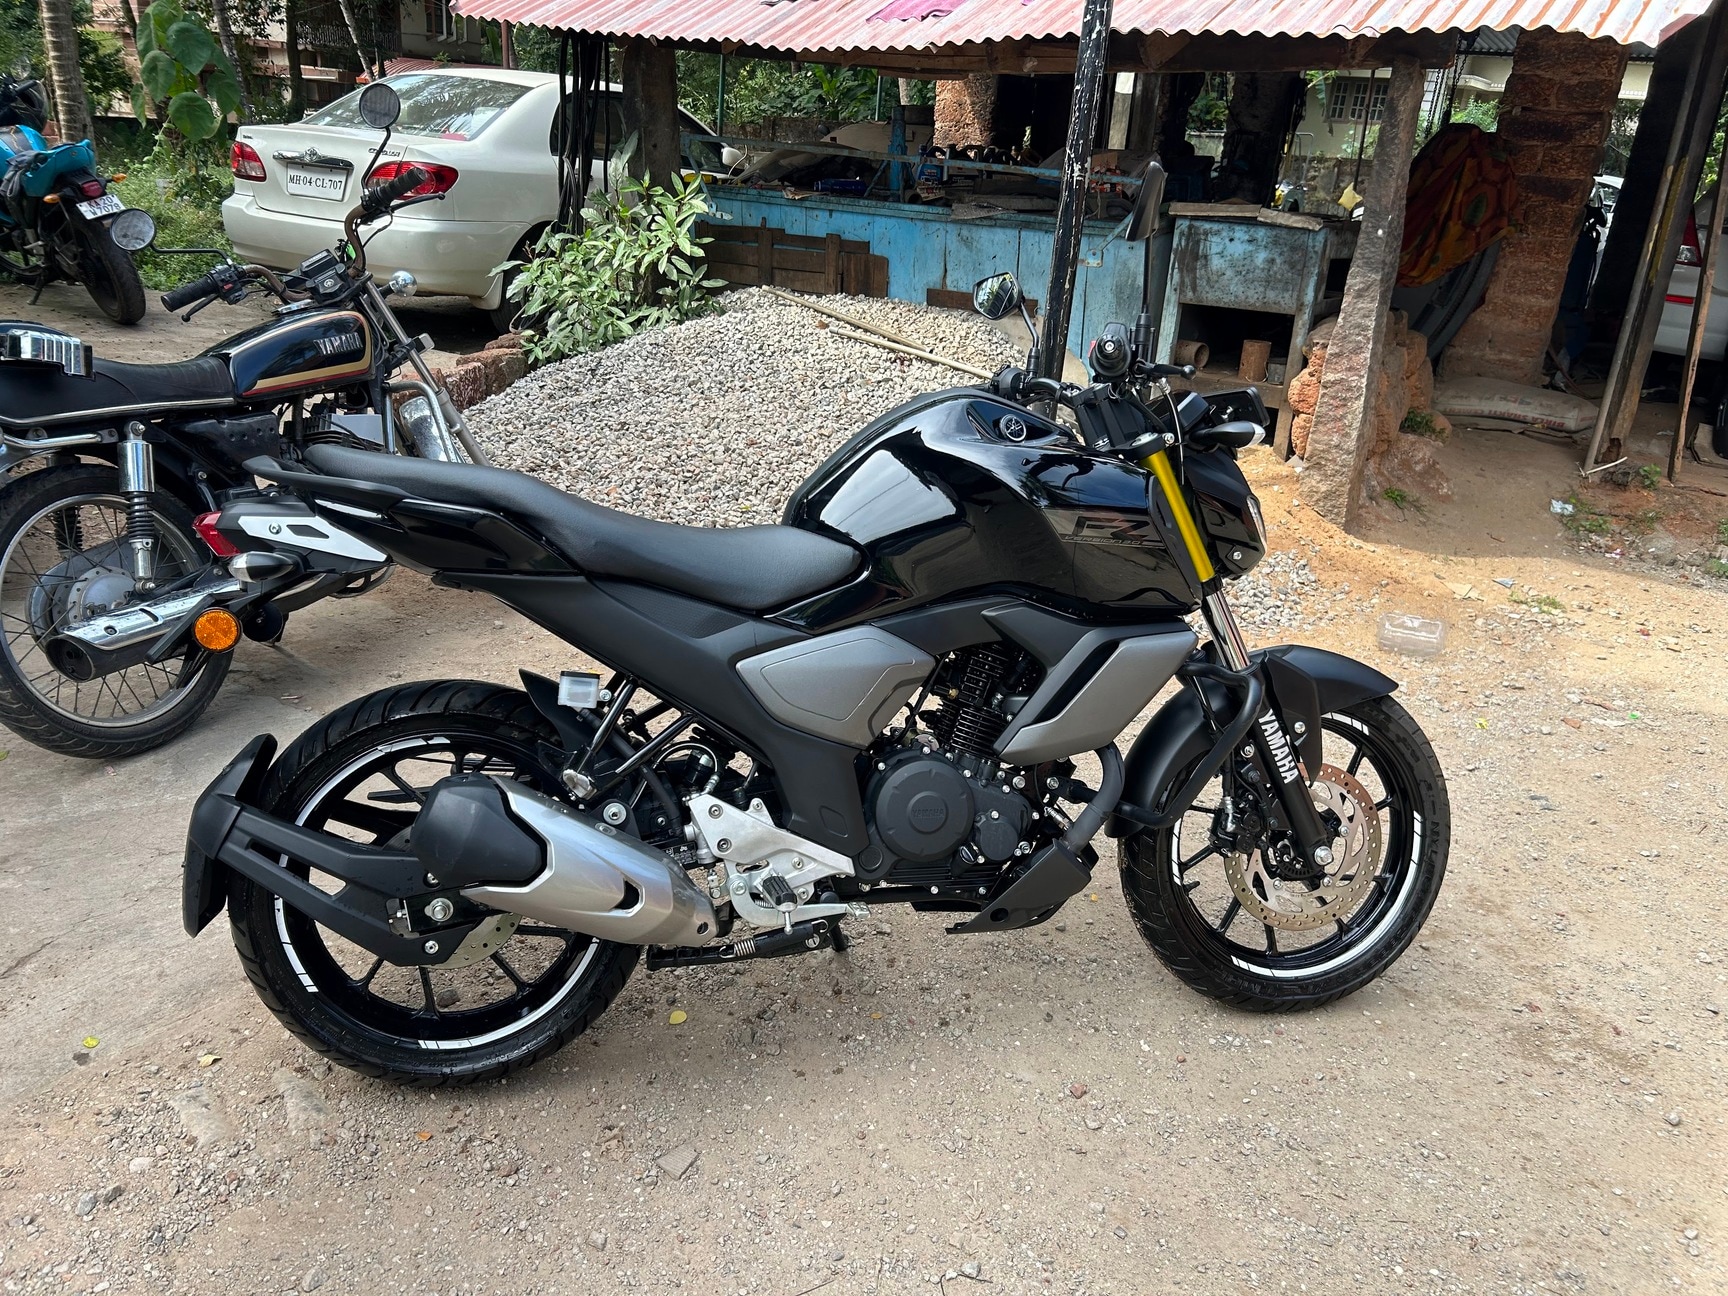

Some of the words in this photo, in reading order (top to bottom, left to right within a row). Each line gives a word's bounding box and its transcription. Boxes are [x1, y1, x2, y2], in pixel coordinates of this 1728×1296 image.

[313, 332, 363, 355] YAMAHA
[1258, 708, 1299, 784] YAMAHA
[912, 808, 945, 818] YAMAHA
